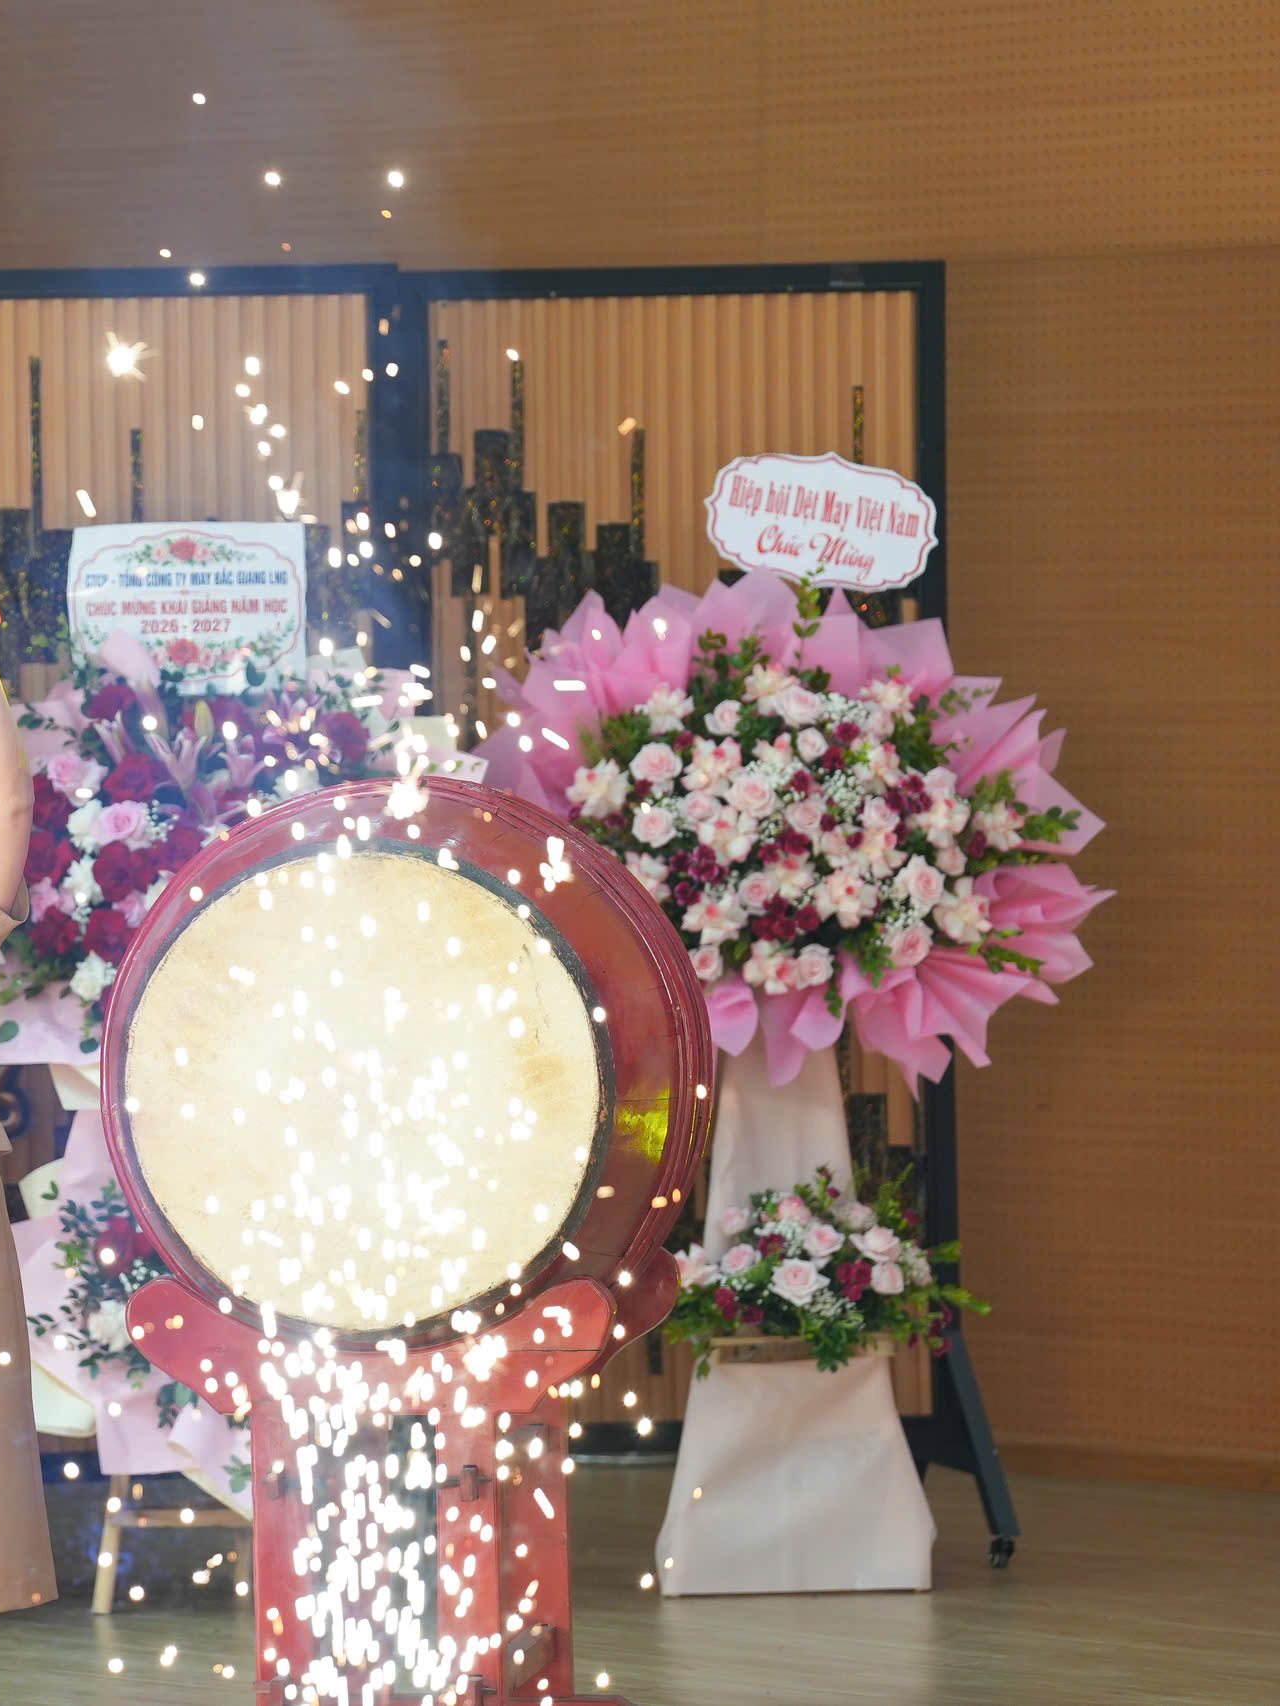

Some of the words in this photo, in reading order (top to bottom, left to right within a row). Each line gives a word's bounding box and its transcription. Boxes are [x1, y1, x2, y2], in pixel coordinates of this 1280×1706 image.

[728, 474, 763, 517] Hiệp
[792, 485, 820, 525] Dệt
[819, 490, 852, 533] May
[856, 495, 886, 535] Việt
[887, 500, 920, 538] Nam
[140, 619, 180, 634] 2026
[191, 618, 233, 634] 2027
